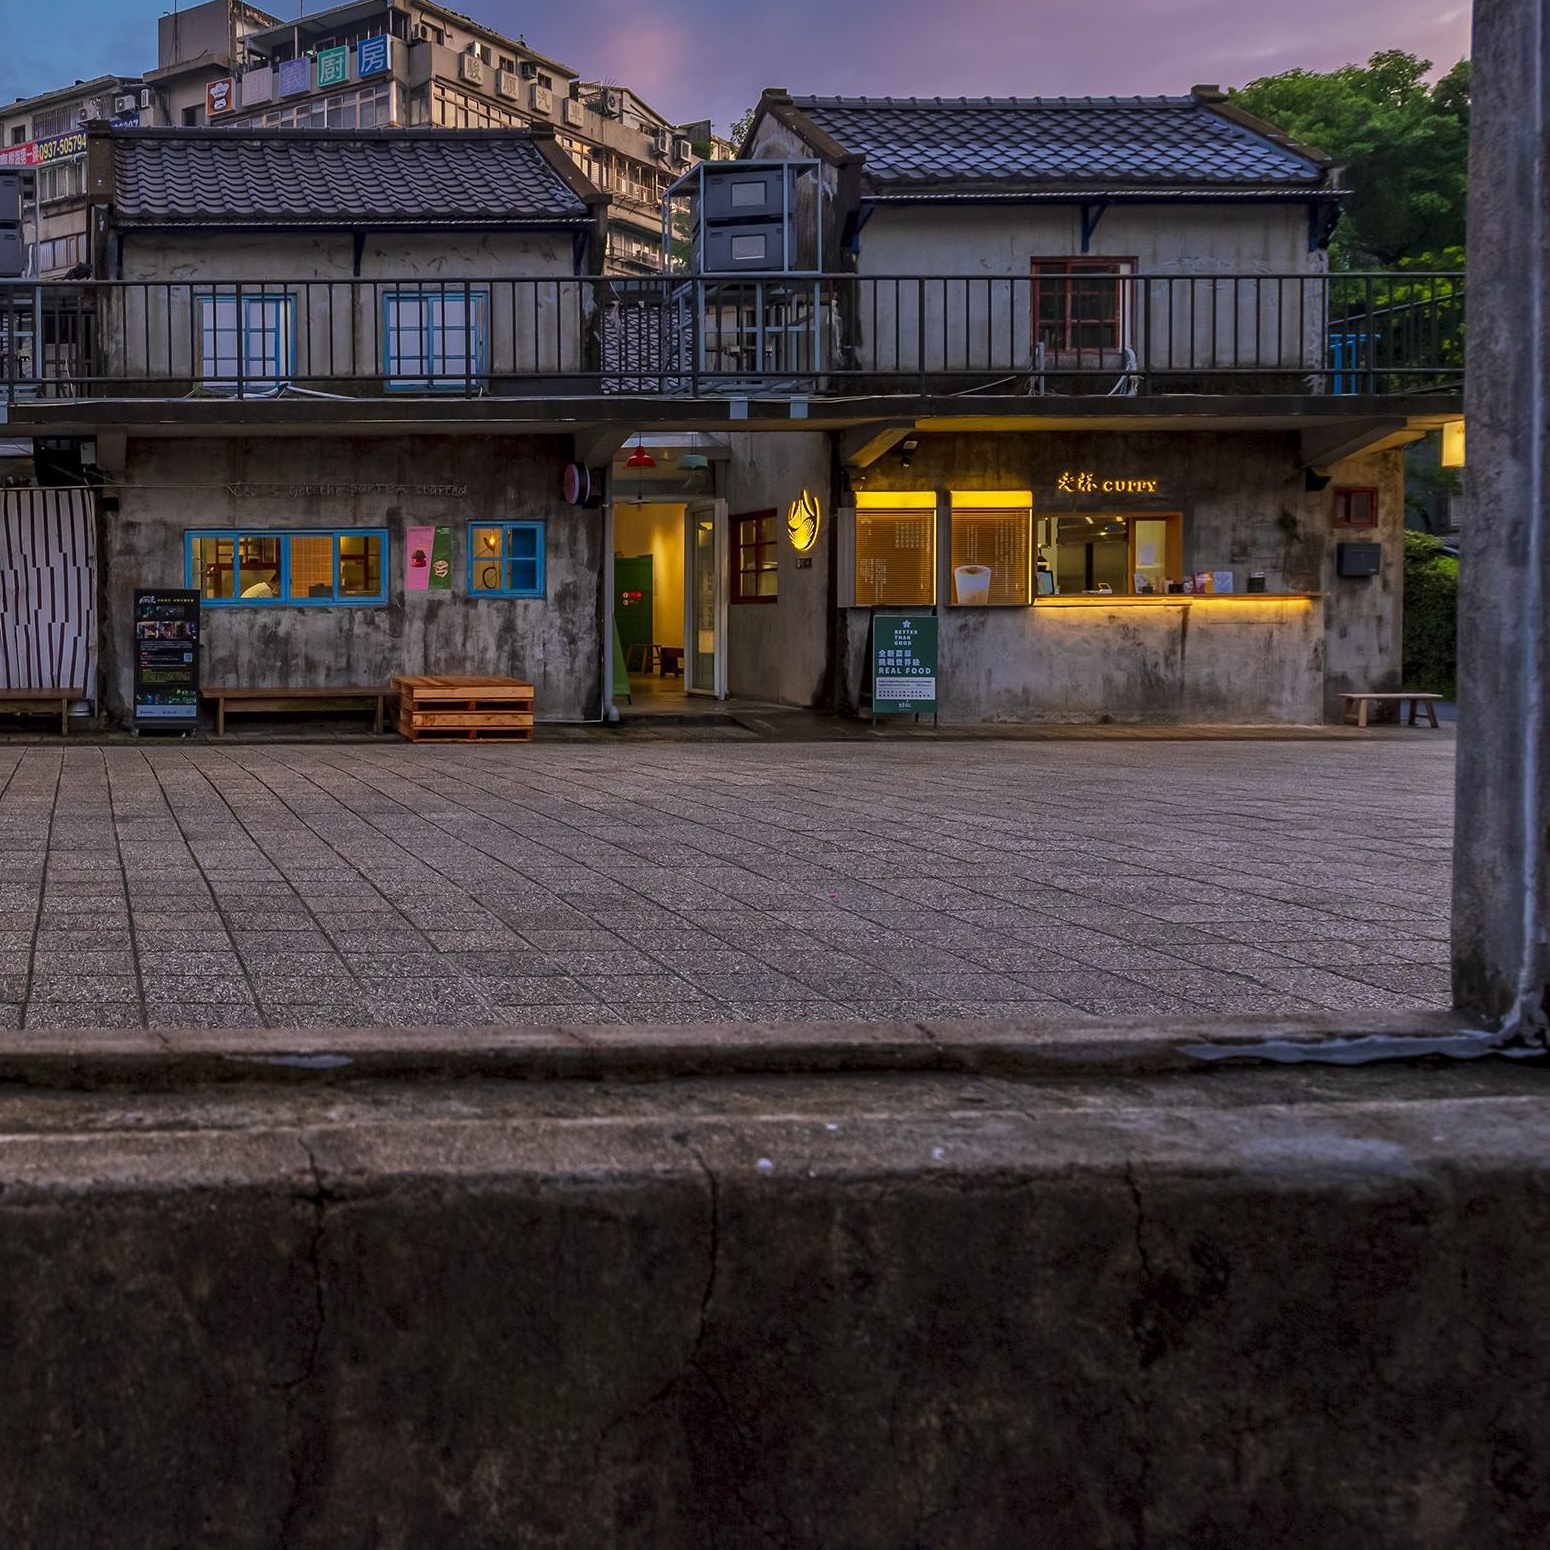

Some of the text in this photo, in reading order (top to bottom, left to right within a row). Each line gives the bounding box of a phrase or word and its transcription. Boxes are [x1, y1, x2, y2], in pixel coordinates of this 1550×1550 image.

[39, 133, 87, 160] 0937-505794
[1103, 480, 1157, 492] CUPPY
[906, 667, 931, 675] FOOD
